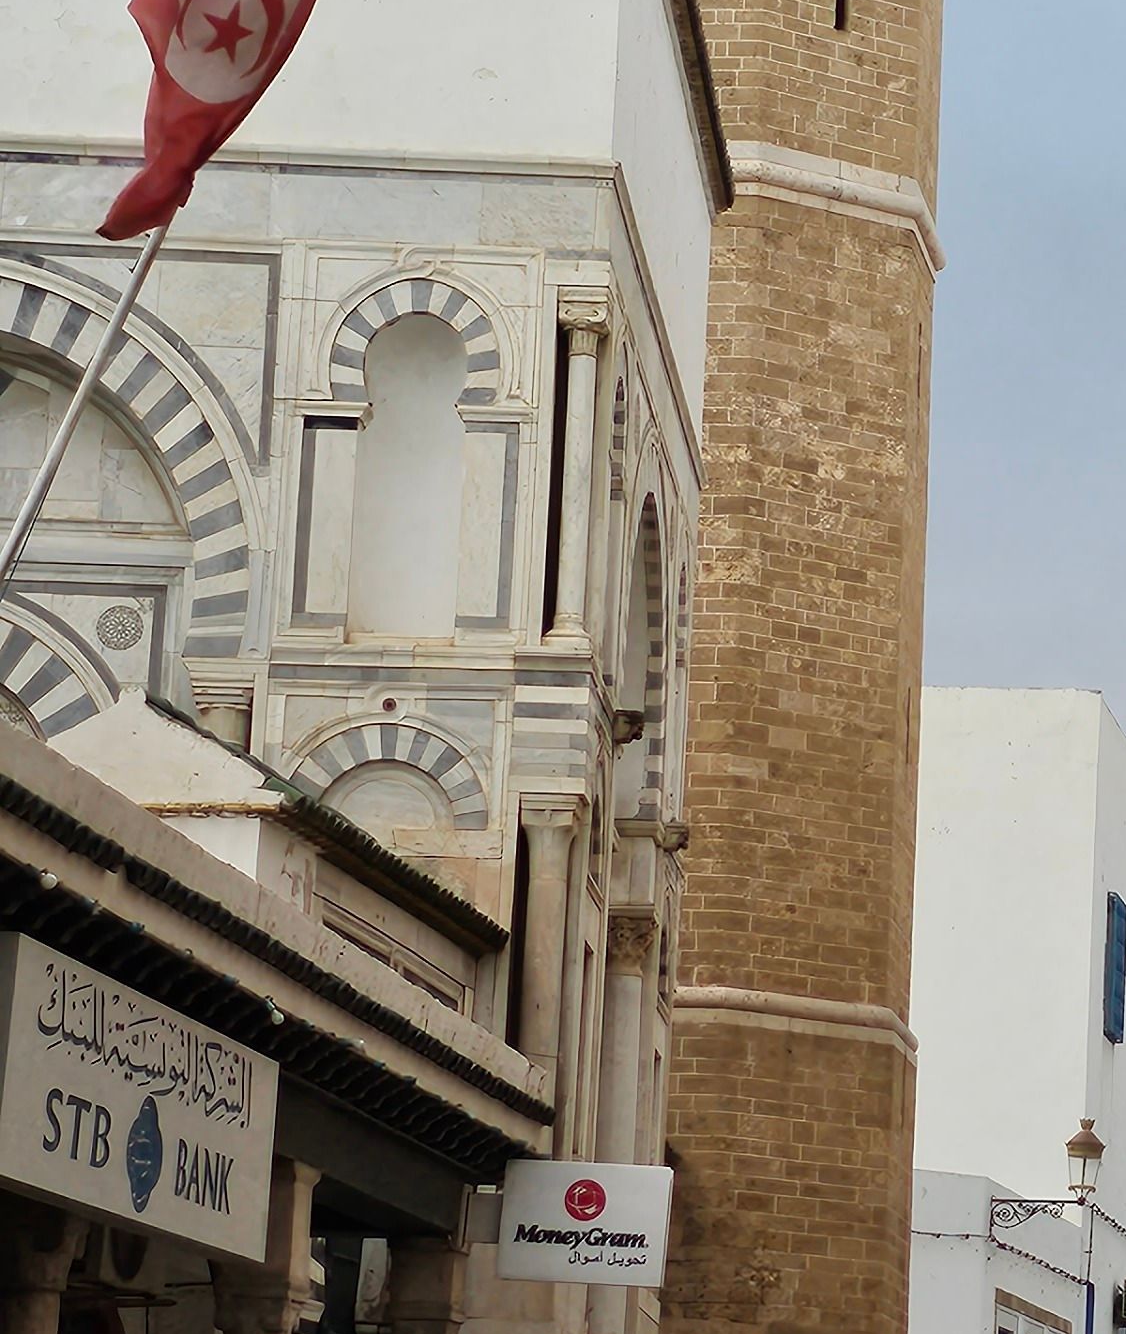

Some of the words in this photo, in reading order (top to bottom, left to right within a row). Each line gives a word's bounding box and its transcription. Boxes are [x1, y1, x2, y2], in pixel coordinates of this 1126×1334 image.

[43, 1088, 111, 1169] STB
[174, 1139, 234, 1215] BANK
[607, 1253, 647, 1267] تحويل
